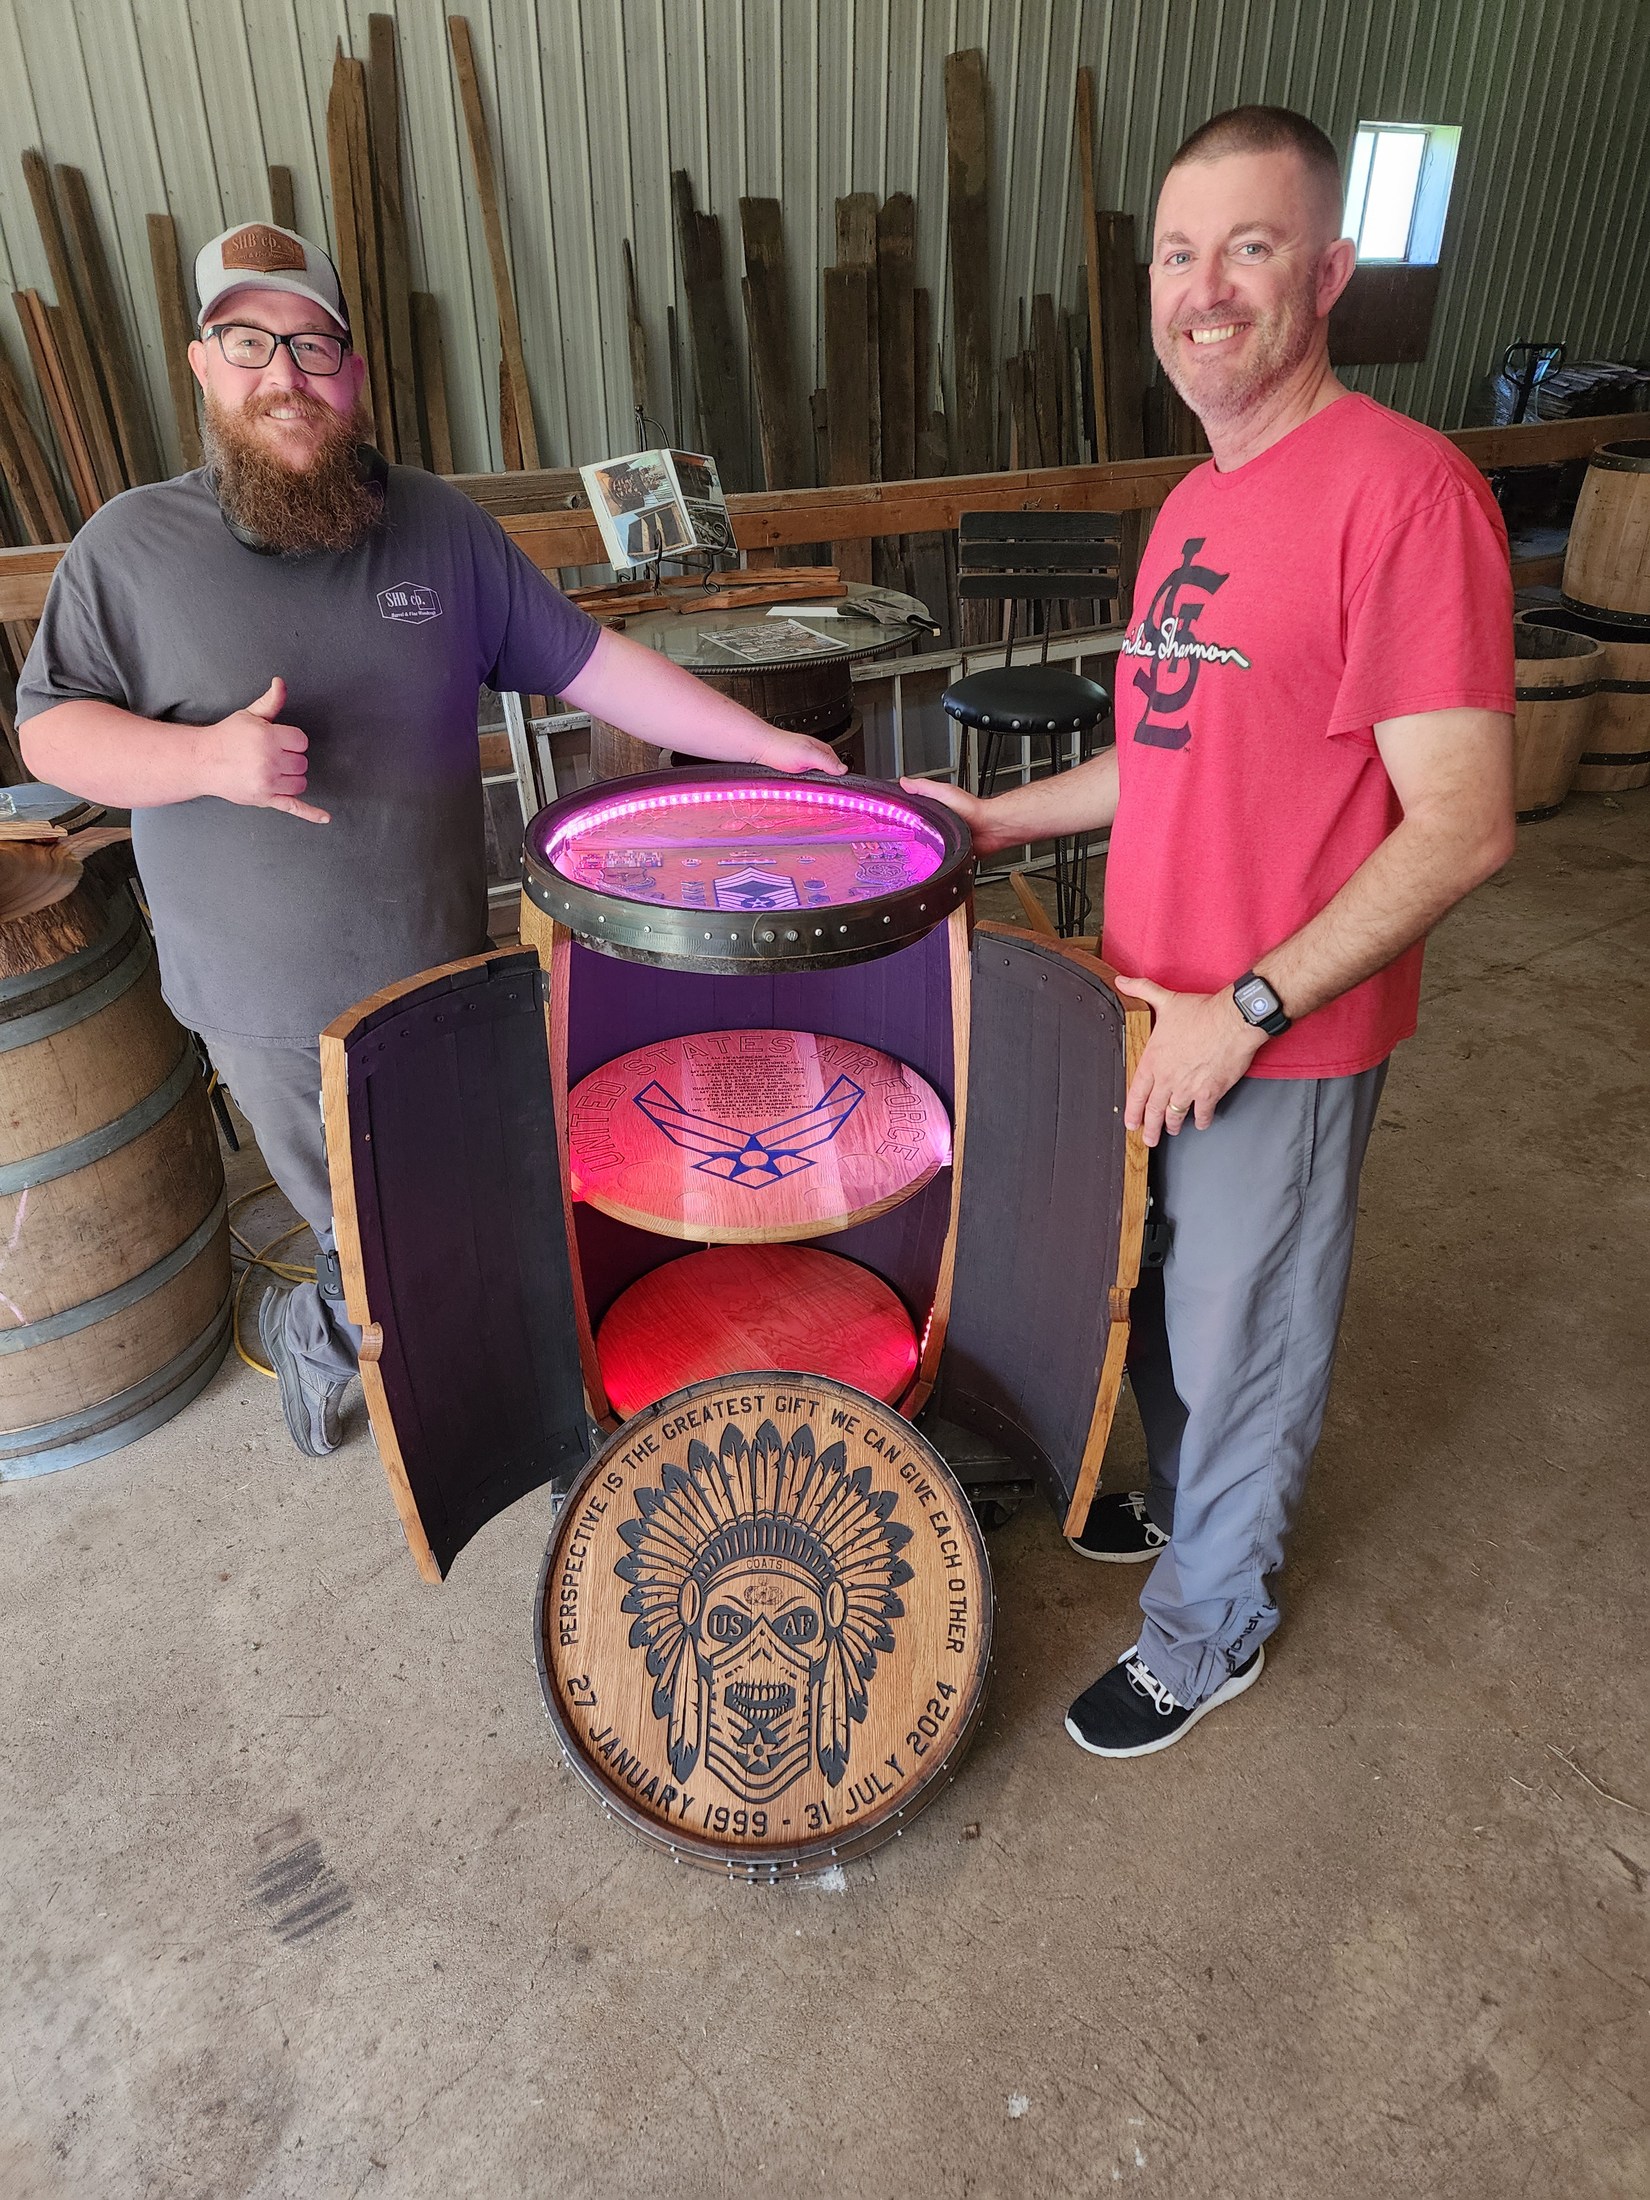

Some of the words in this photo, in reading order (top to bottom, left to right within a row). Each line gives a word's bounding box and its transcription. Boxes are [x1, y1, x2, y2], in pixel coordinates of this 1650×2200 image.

[232, 233, 257, 251] SHB
[385, 591, 408, 608] SHB
[571, 1080, 627, 1172] UNITED
[622, 1036, 795, 1075] STATES
[810, 1045, 878, 1075] AIR
[871, 1076, 927, 1161] FORCE
[560, 1496, 608, 1647] PERSPECTIVE
[602, 1472, 624, 1495] IS
[621, 1435, 660, 1470] THE
[662, 1395, 766, 1440] GREATEST
[775, 1396, 819, 1417] GIFT
[831, 1408, 860, 1435] WE
[864, 1428, 901, 1464] CAN
[900, 1462, 937, 1507] GIVE
[930, 1510, 962, 1569] EACH
[946, 1578, 967, 1654] OTHER
[746, 1558, 783, 1570] COATS
[713, 1614, 743, 1637] US
[782, 1614, 813, 1636] AF
[567, 1674, 598, 1706] 27
[589, 1726, 695, 1820] JANUARY
[703, 1803, 768, 1837] 1999
[804, 1800, 832, 1829] 31
[845, 1753, 905, 1814] JULY
[906, 1680, 957, 1757] 2024
